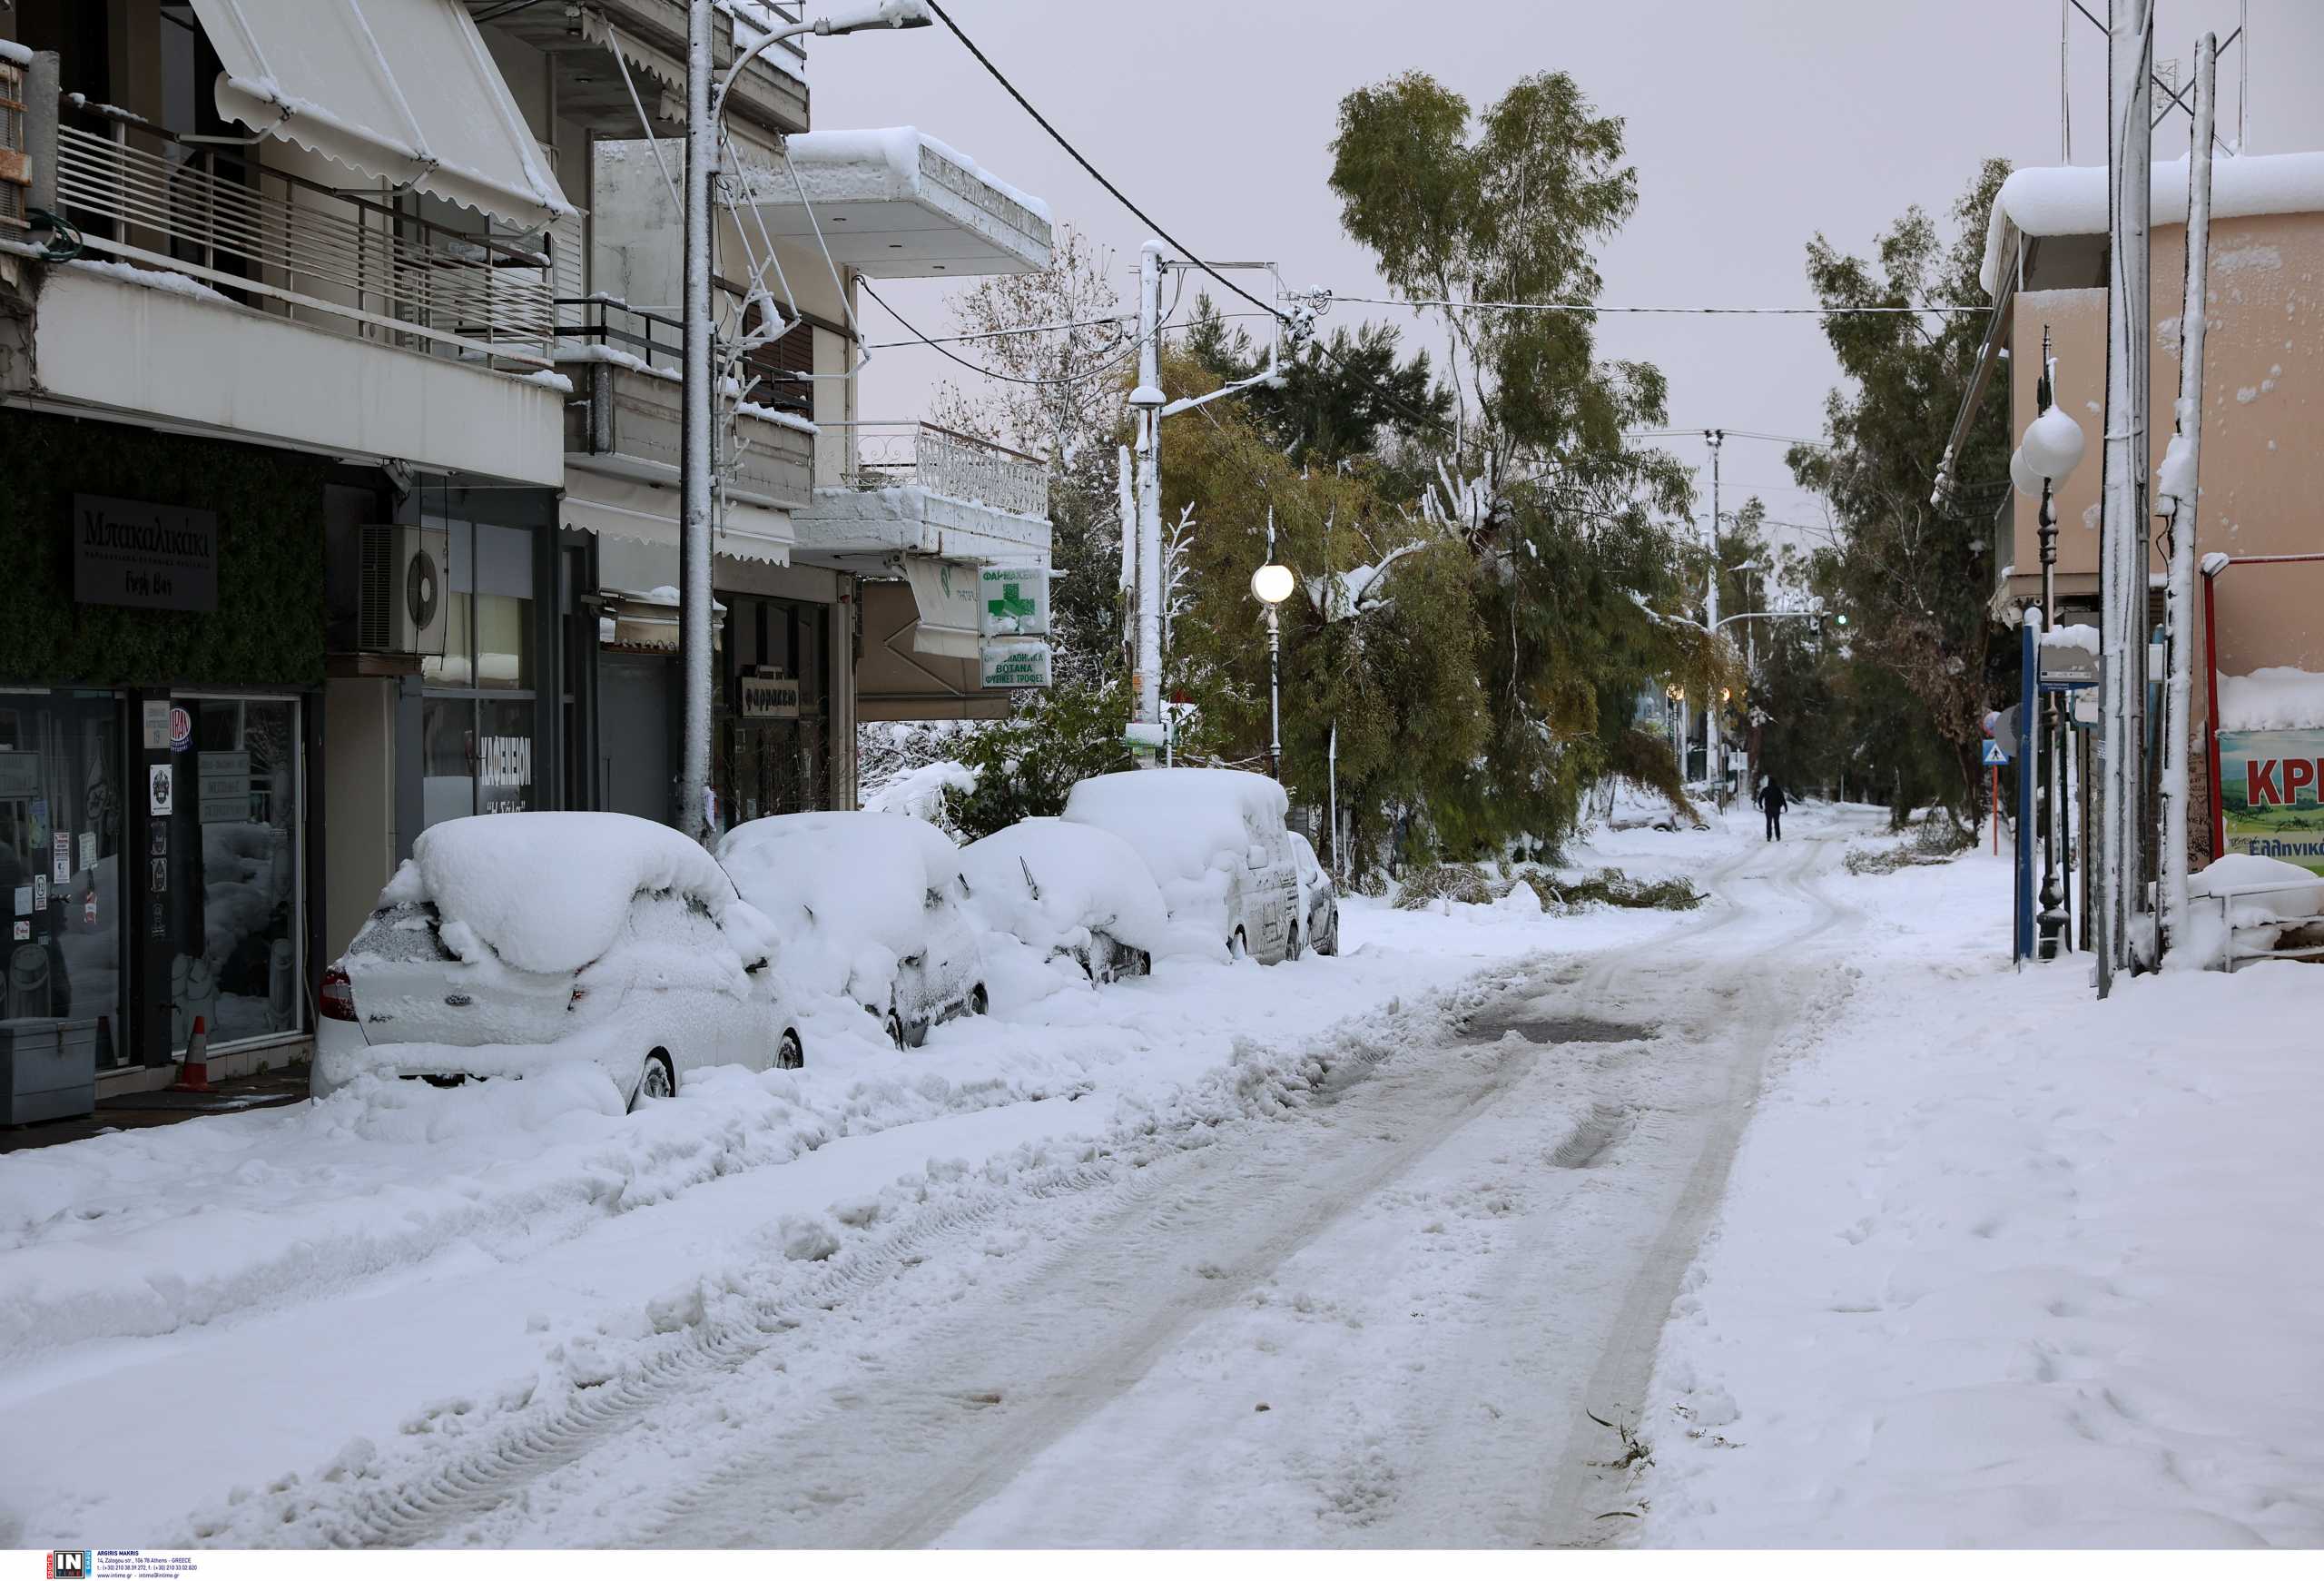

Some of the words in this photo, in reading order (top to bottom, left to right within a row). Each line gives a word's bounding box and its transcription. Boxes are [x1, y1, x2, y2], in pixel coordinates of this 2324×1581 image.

[81, 509, 211, 558] Μπακαλικάκι
[986, 675, 1014, 684] ΦΥΣΙΚΕΣ
[1017, 674, 1044, 684] ΤΡΟΦΕΣ
[996, 664, 1033, 674] ΒΟΤΑΝΑ
[481, 735, 531, 786] ΚΑΦΕΝΕΙΟΝ
